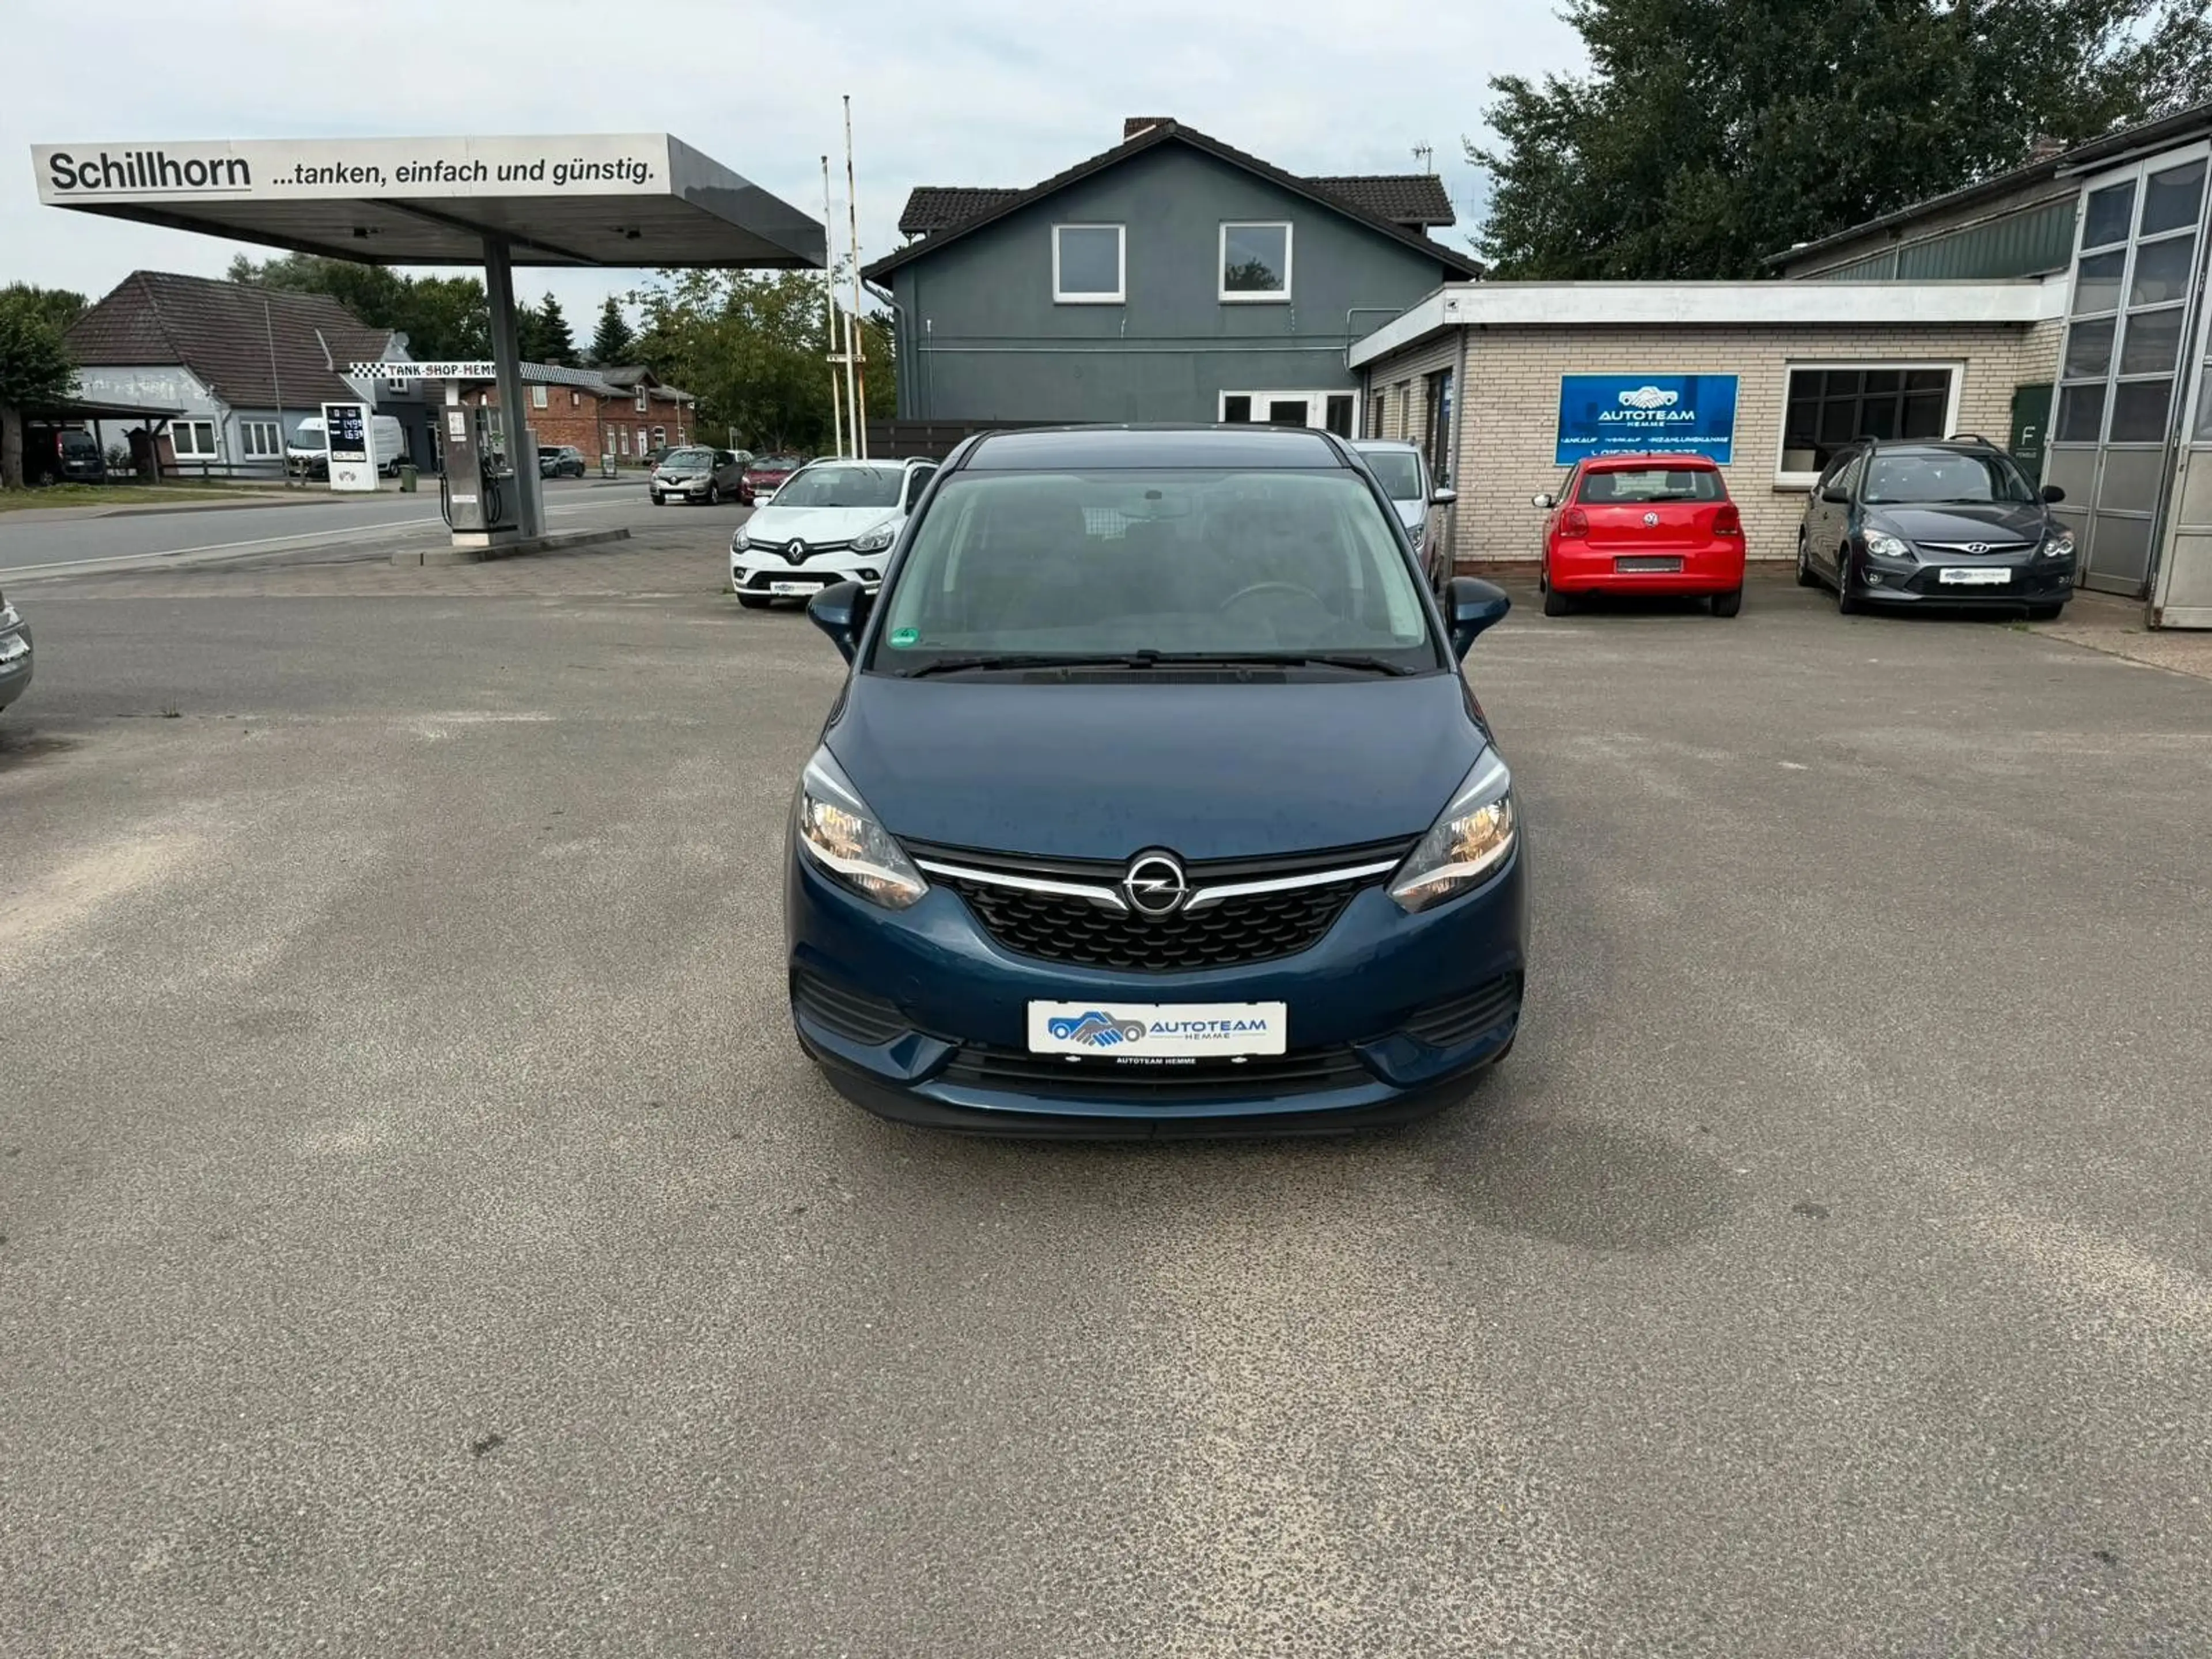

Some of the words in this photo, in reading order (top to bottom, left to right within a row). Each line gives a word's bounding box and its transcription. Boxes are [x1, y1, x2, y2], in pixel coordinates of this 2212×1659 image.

[50, 151, 251, 190] Schillhorn
[395, 160, 487, 183] einfach
[497, 158, 545, 181] und
[552, 157, 654, 185] günstig.
[1598, 410, 1695, 421] AUTOTEAM
[1150, 1019, 1267, 1033] AUTOTEAM
